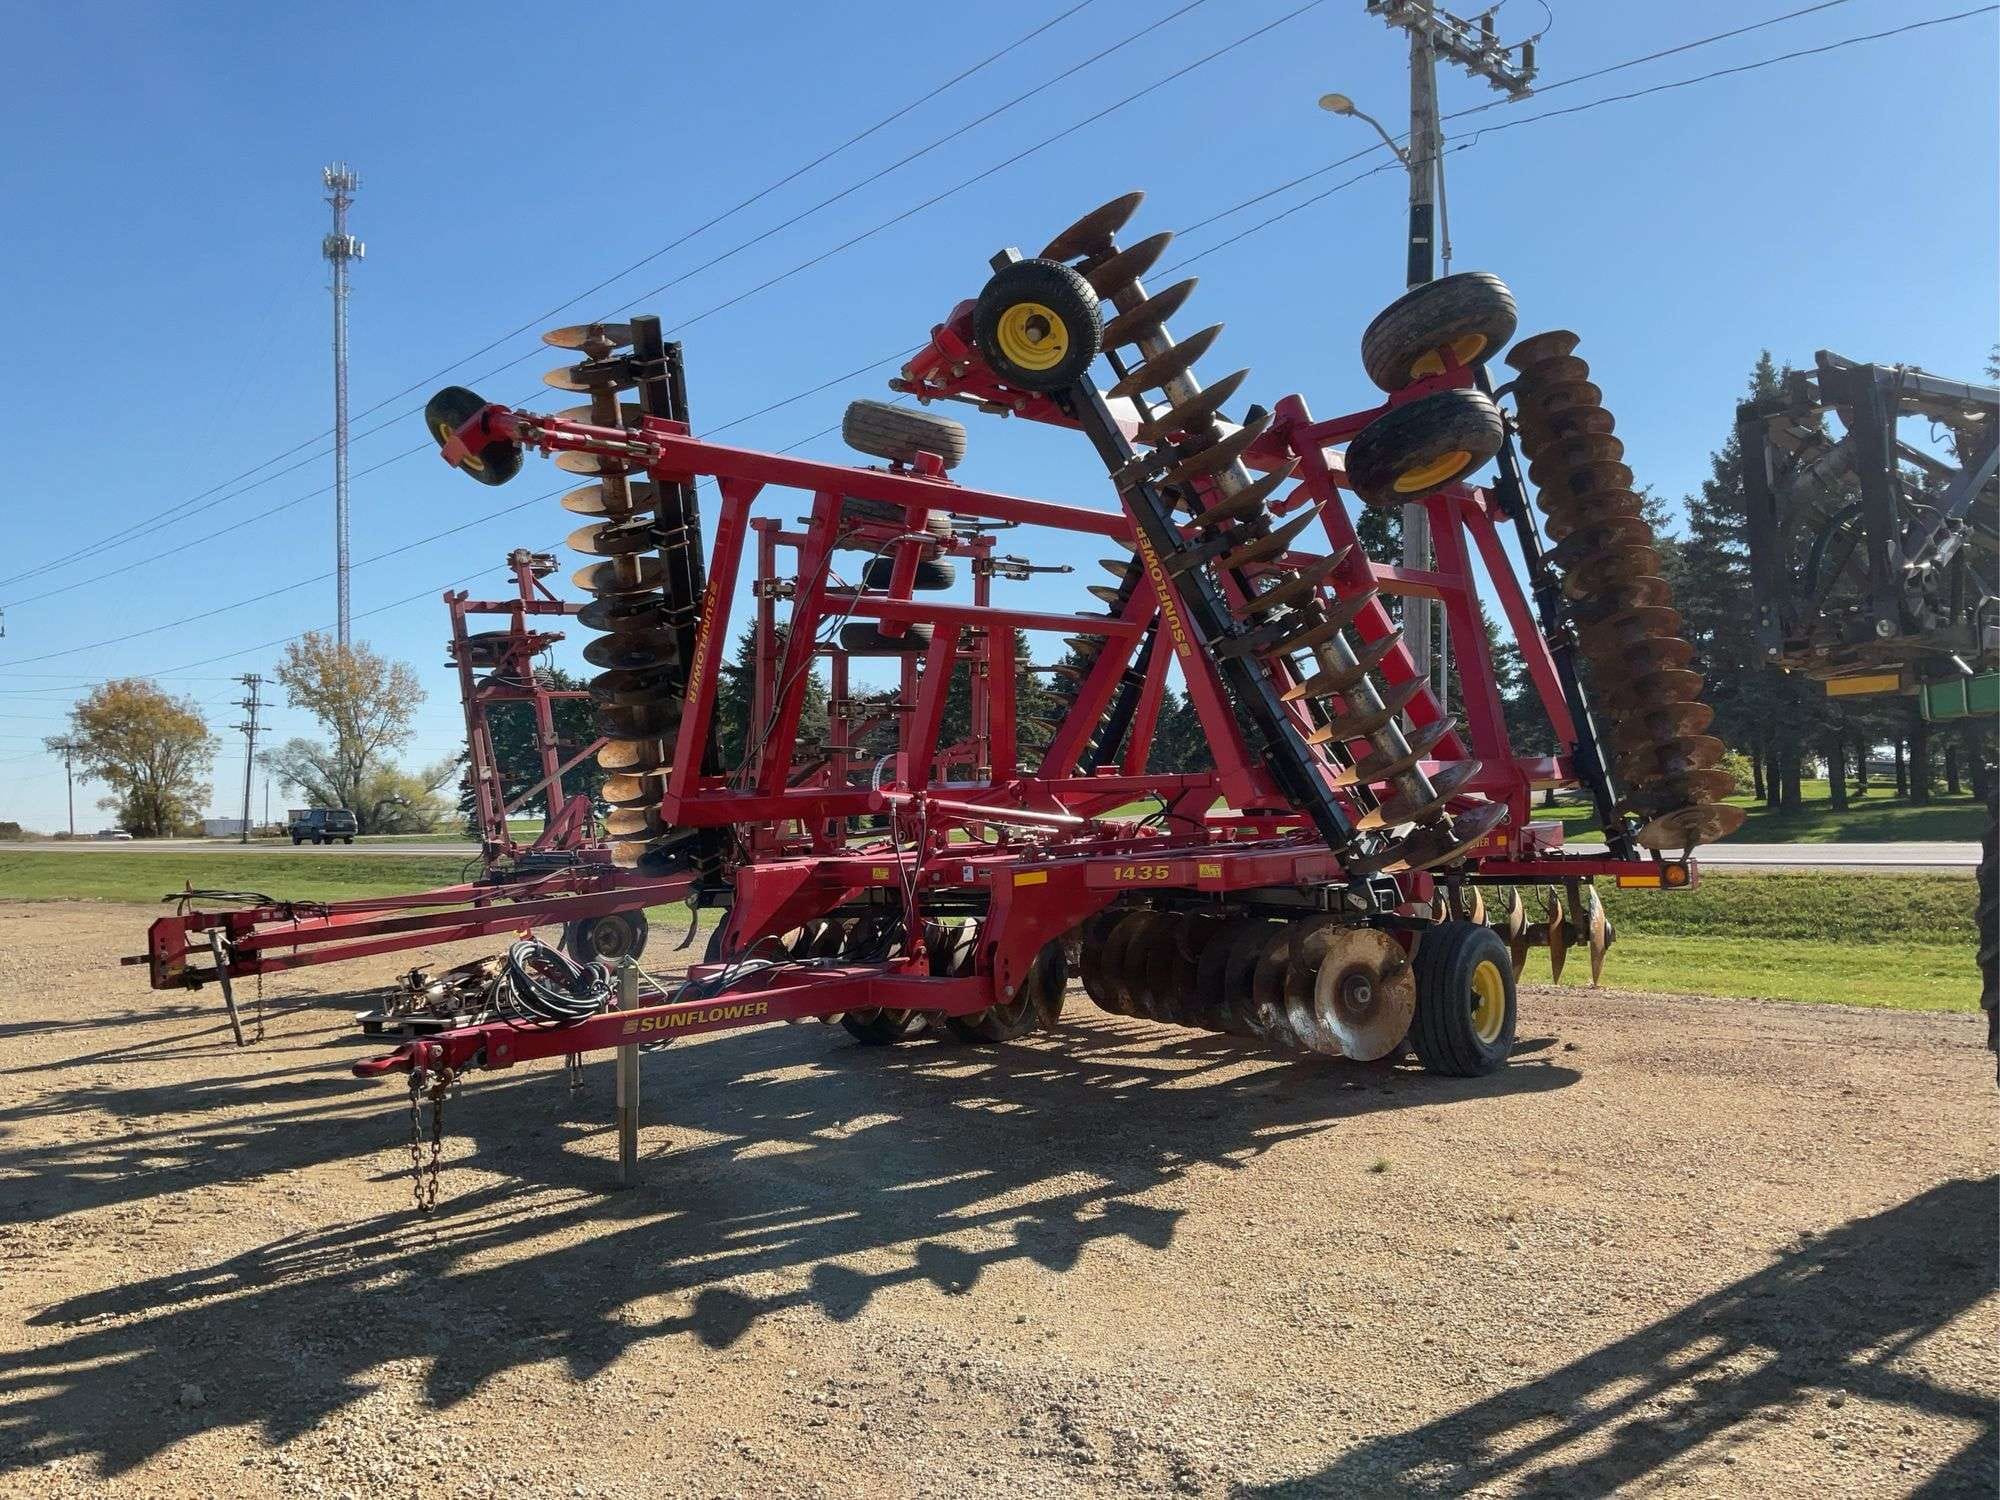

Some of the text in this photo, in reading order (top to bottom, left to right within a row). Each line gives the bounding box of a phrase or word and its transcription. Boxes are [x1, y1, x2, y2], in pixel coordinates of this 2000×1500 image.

[1136, 526, 1186, 642] SUNFLOWER
[688, 594, 716, 704] SUNFLOWER
[1113, 865, 1170, 881] 1435
[640, 1001, 769, 1032] SUNFLOWER
